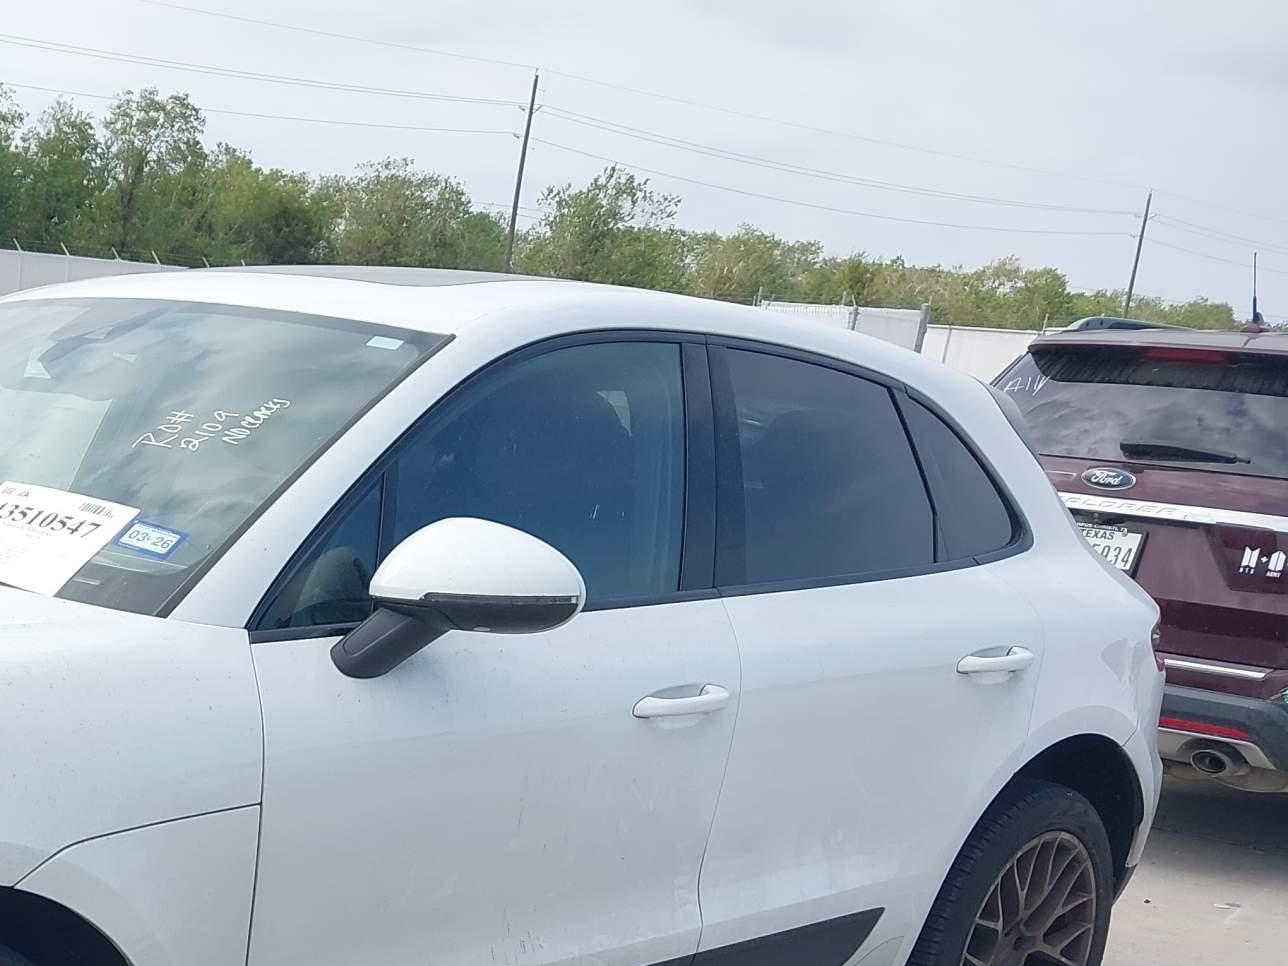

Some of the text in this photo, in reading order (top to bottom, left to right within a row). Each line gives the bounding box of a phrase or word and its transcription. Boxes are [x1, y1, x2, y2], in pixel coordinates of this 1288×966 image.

[180, 411, 239, 451] 2109
[1091, 470, 1124, 485] Ford
[1065, 497, 1177, 515] PLORER
[128, 529, 174, 549] 03 26
[1080, 528, 1115, 540] TEXAS
